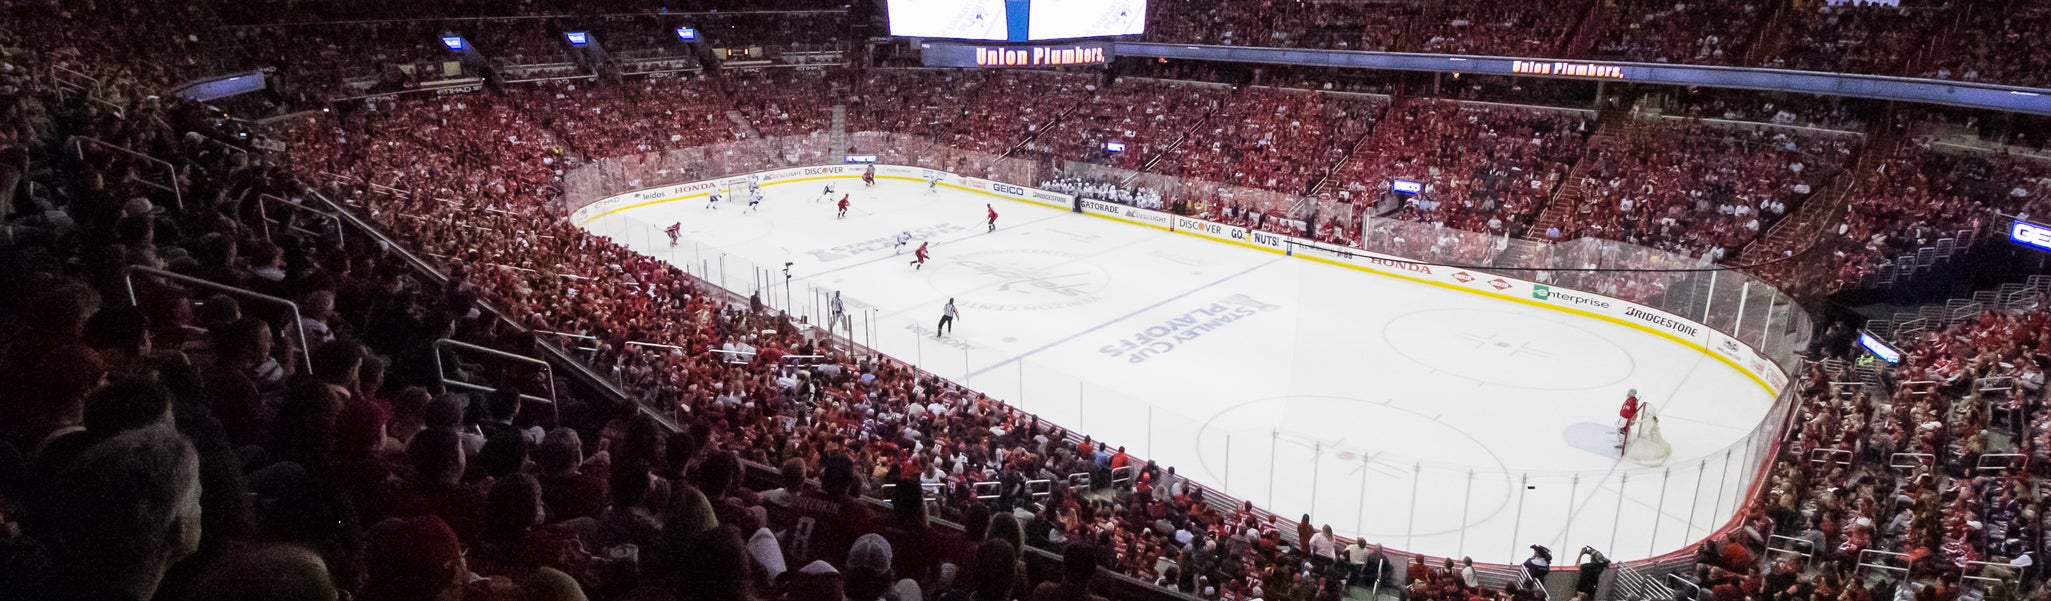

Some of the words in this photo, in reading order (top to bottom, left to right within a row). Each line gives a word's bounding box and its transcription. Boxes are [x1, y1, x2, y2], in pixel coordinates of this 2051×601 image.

[976, 47, 1029, 66] Union
[1033, 46, 1105, 65] Plumbers,
[1513, 60, 1551, 75] Union
[804, 166, 844, 176] DISCOVER
[642, 191, 666, 201] leidos
[674, 182, 717, 194] HONDA
[993, 183, 1025, 196] GEICO
[1080, 200, 1119, 215] GATORADE
[1179, 218, 1222, 235] DISCOVER
[1254, 232, 1280, 248] NUTS!
[1370, 256, 1433, 275] HONDA
[1538, 288, 1611, 309] enterprise
[1099, 303, 1229, 358] PLAYOFFS
[1172, 306, 1258, 344] STANLEY
[1624, 306, 1699, 338] BRIDGESTONE
[1128, 341, 1175, 364] CUP
